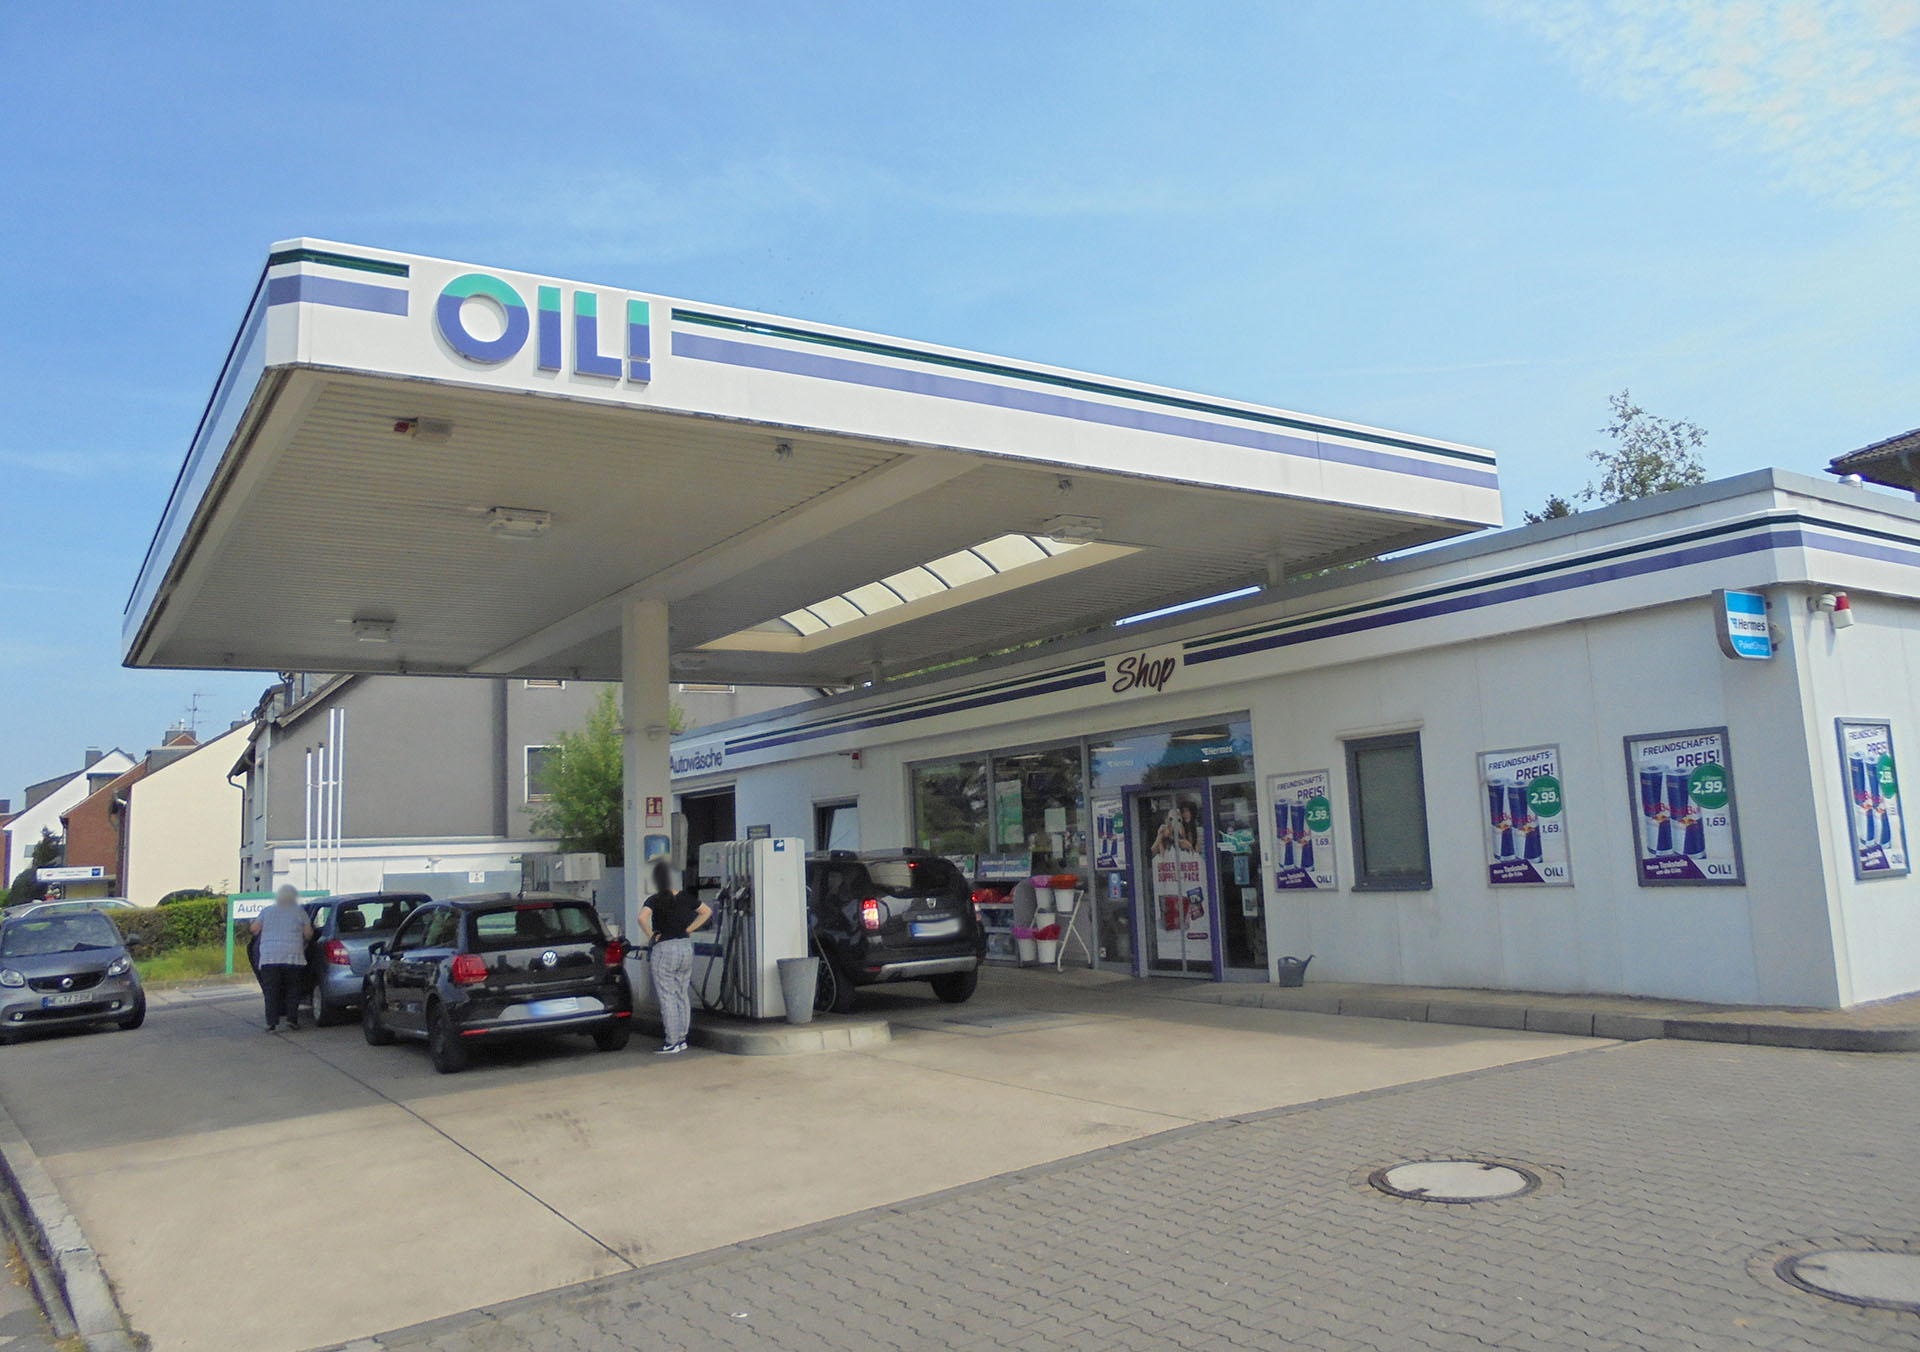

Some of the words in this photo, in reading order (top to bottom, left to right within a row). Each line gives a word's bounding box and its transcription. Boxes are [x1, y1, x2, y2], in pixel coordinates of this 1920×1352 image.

[436, 273, 651, 385] OIL!
[1738, 617, 1766, 631] Hermes
[1112, 653, 1175, 693] Shop
[1642, 736, 1719, 757] FREUNDSCHAFTS-
[1488, 751, 1553, 770] FREUNDSCHAFTS-
[1676, 749, 1720, 768] PREIS!
[1516, 763, 1554, 780] PREIS!
[1297, 786, 1326, 800] PREIS!
[1544, 867, 1564, 877] OIL!
[1708, 864, 1732, 875] OIL!
[1316, 875, 1332, 884] OIL!
